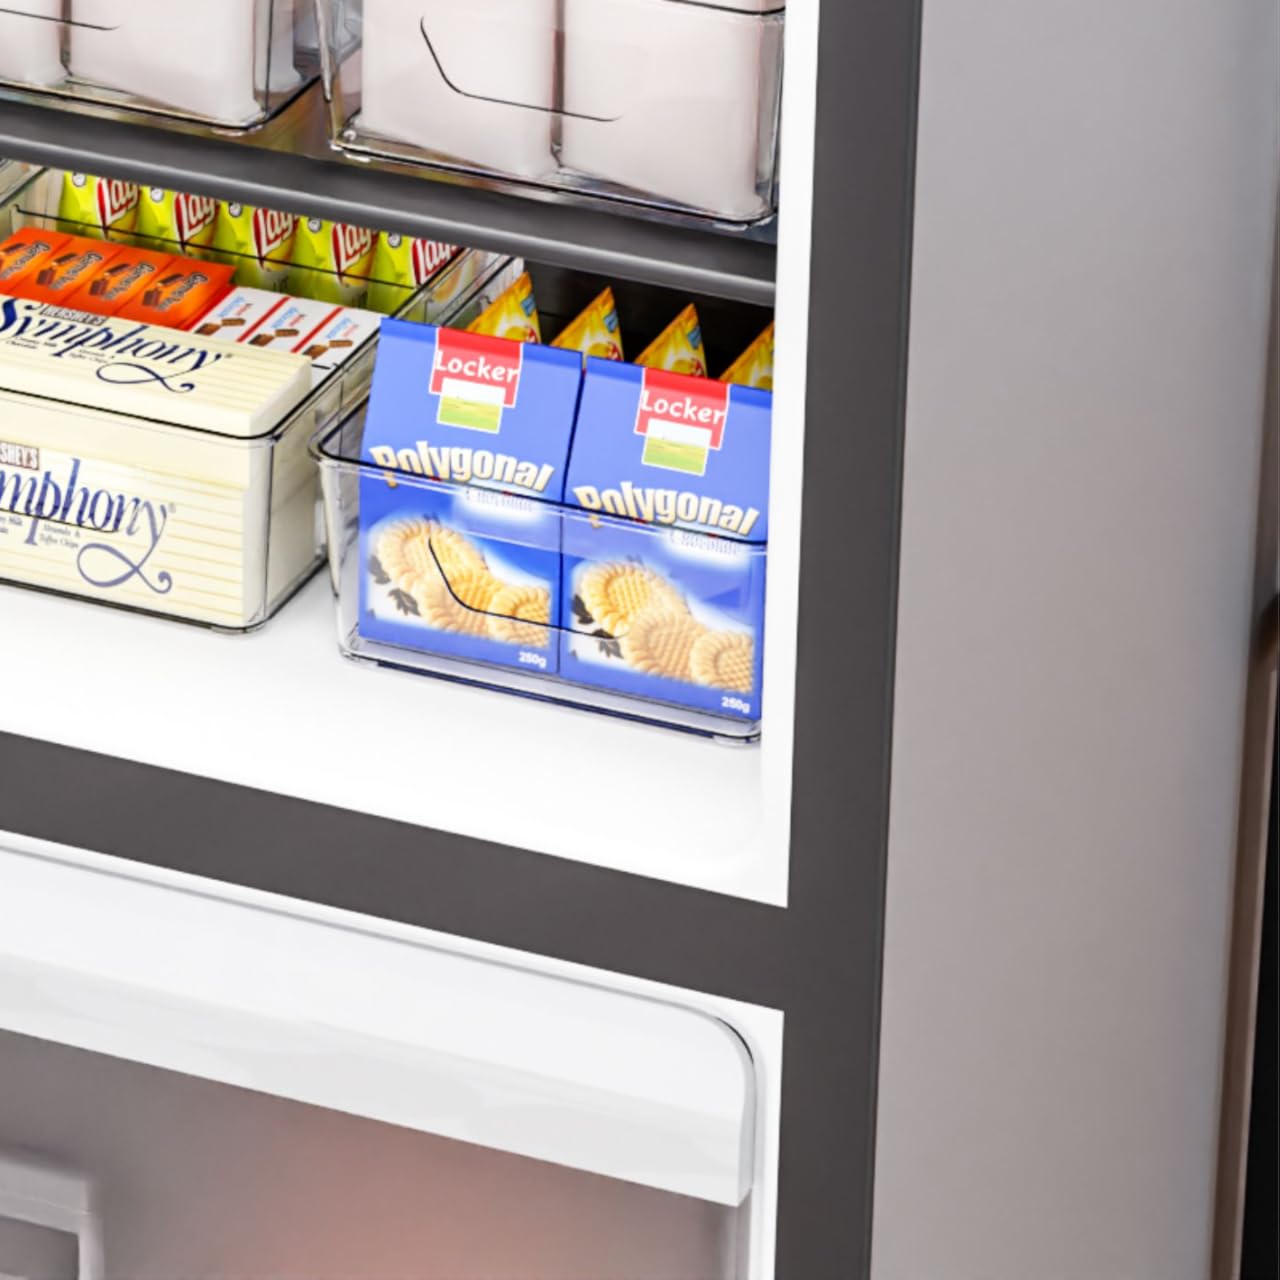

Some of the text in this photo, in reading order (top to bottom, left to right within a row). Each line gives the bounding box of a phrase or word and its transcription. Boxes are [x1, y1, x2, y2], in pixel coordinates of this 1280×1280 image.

[102, 177, 140, 225] Lay
[179, 192, 218, 241] Lay
[257, 208, 296, 256] Lay
[335, 223, 374, 272] Lay
[435, 349, 520, 383] Locker
[640, 389, 727, 425] Locker
[369, 440, 554, 493] Polygonal
[573, 481, 760, 536] Polygonal
[519, 651, 548, 669] 250g
[722, 696, 751, 714] 250g
